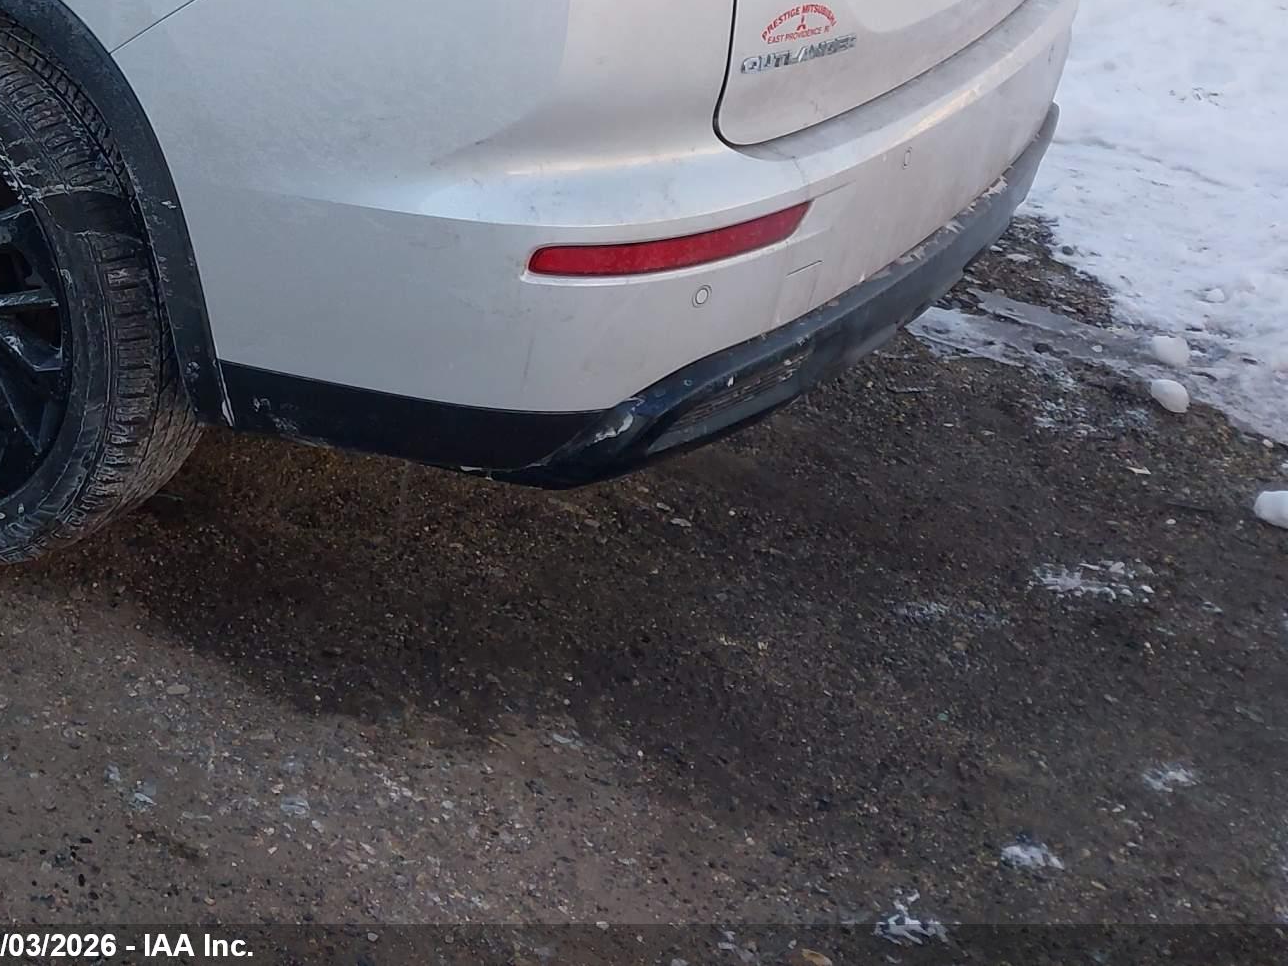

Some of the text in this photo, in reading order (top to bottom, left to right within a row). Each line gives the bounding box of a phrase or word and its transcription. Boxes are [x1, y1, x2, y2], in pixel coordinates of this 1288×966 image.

[761, 7, 800, 41] PRESTIGE
[767, 34, 785, 44] EAST
[785, 27, 822, 42] PROVIDENCE
[741, 33, 858, 74] OUTLANDER
